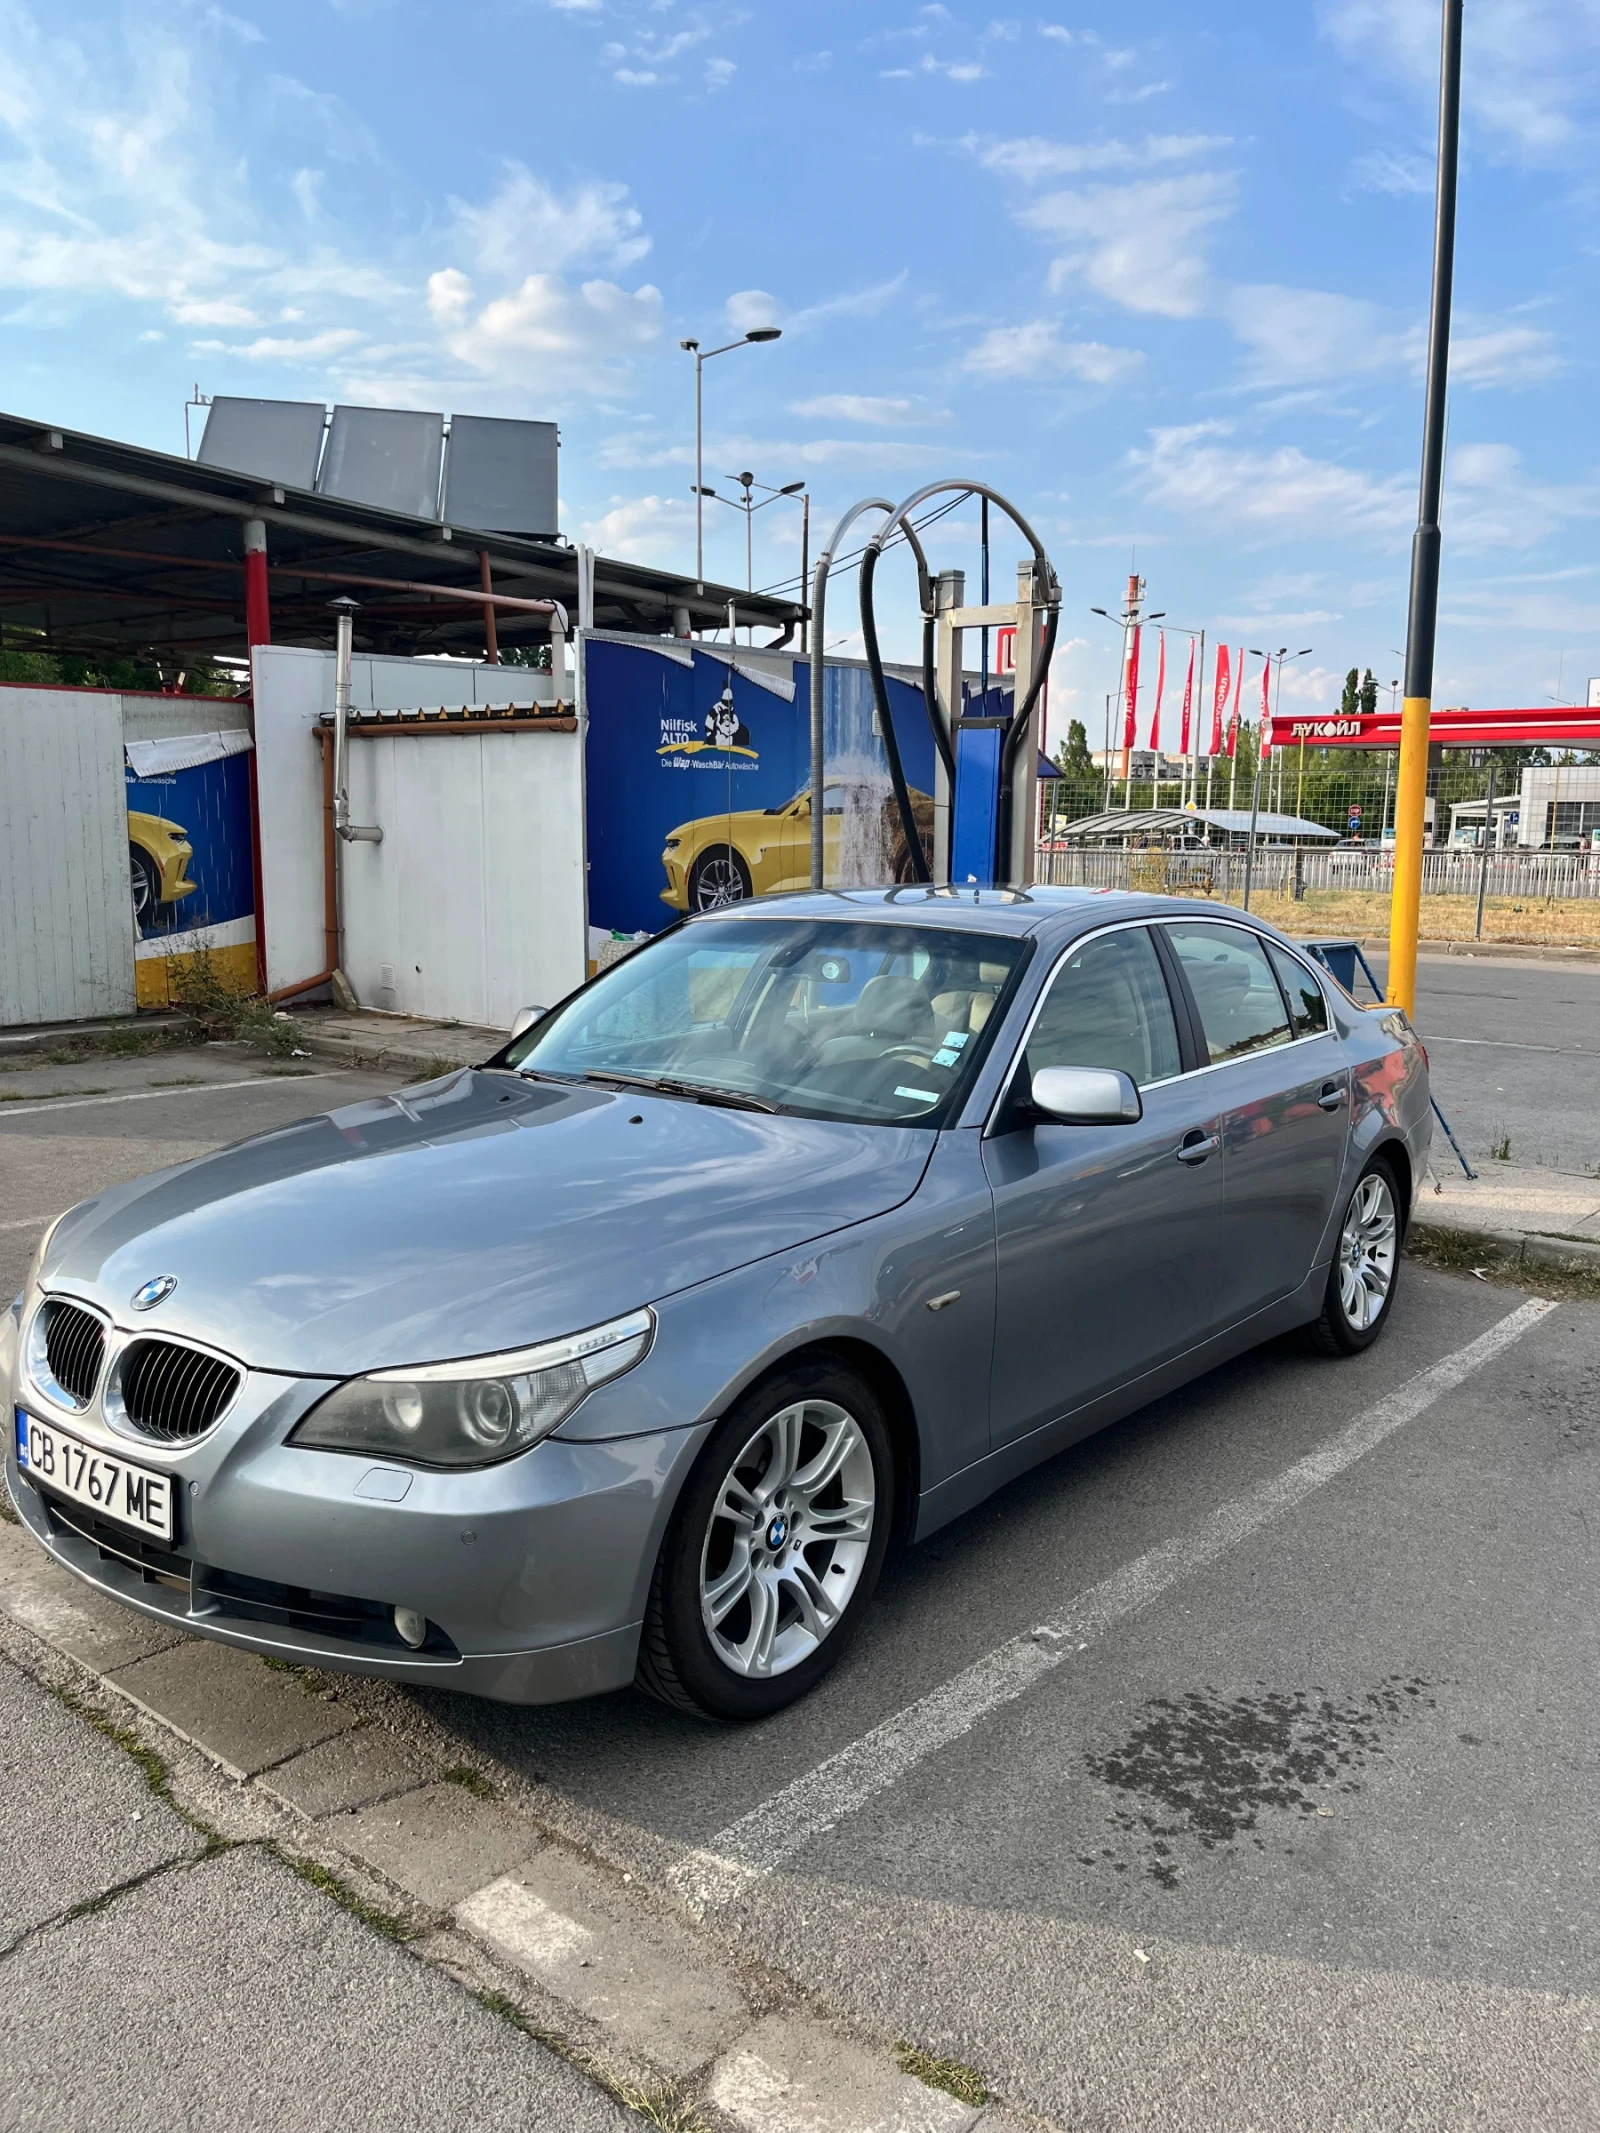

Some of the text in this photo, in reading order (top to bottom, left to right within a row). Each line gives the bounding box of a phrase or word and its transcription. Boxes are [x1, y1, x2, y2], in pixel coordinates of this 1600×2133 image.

[661, 719, 698, 733] Nilfisk
[660, 732, 690, 745] ALTO
[661, 759, 673, 768] Die
[725, 761, 760, 771] Autowäsche
[30, 1425, 166, 1529] CB 1767 ME
